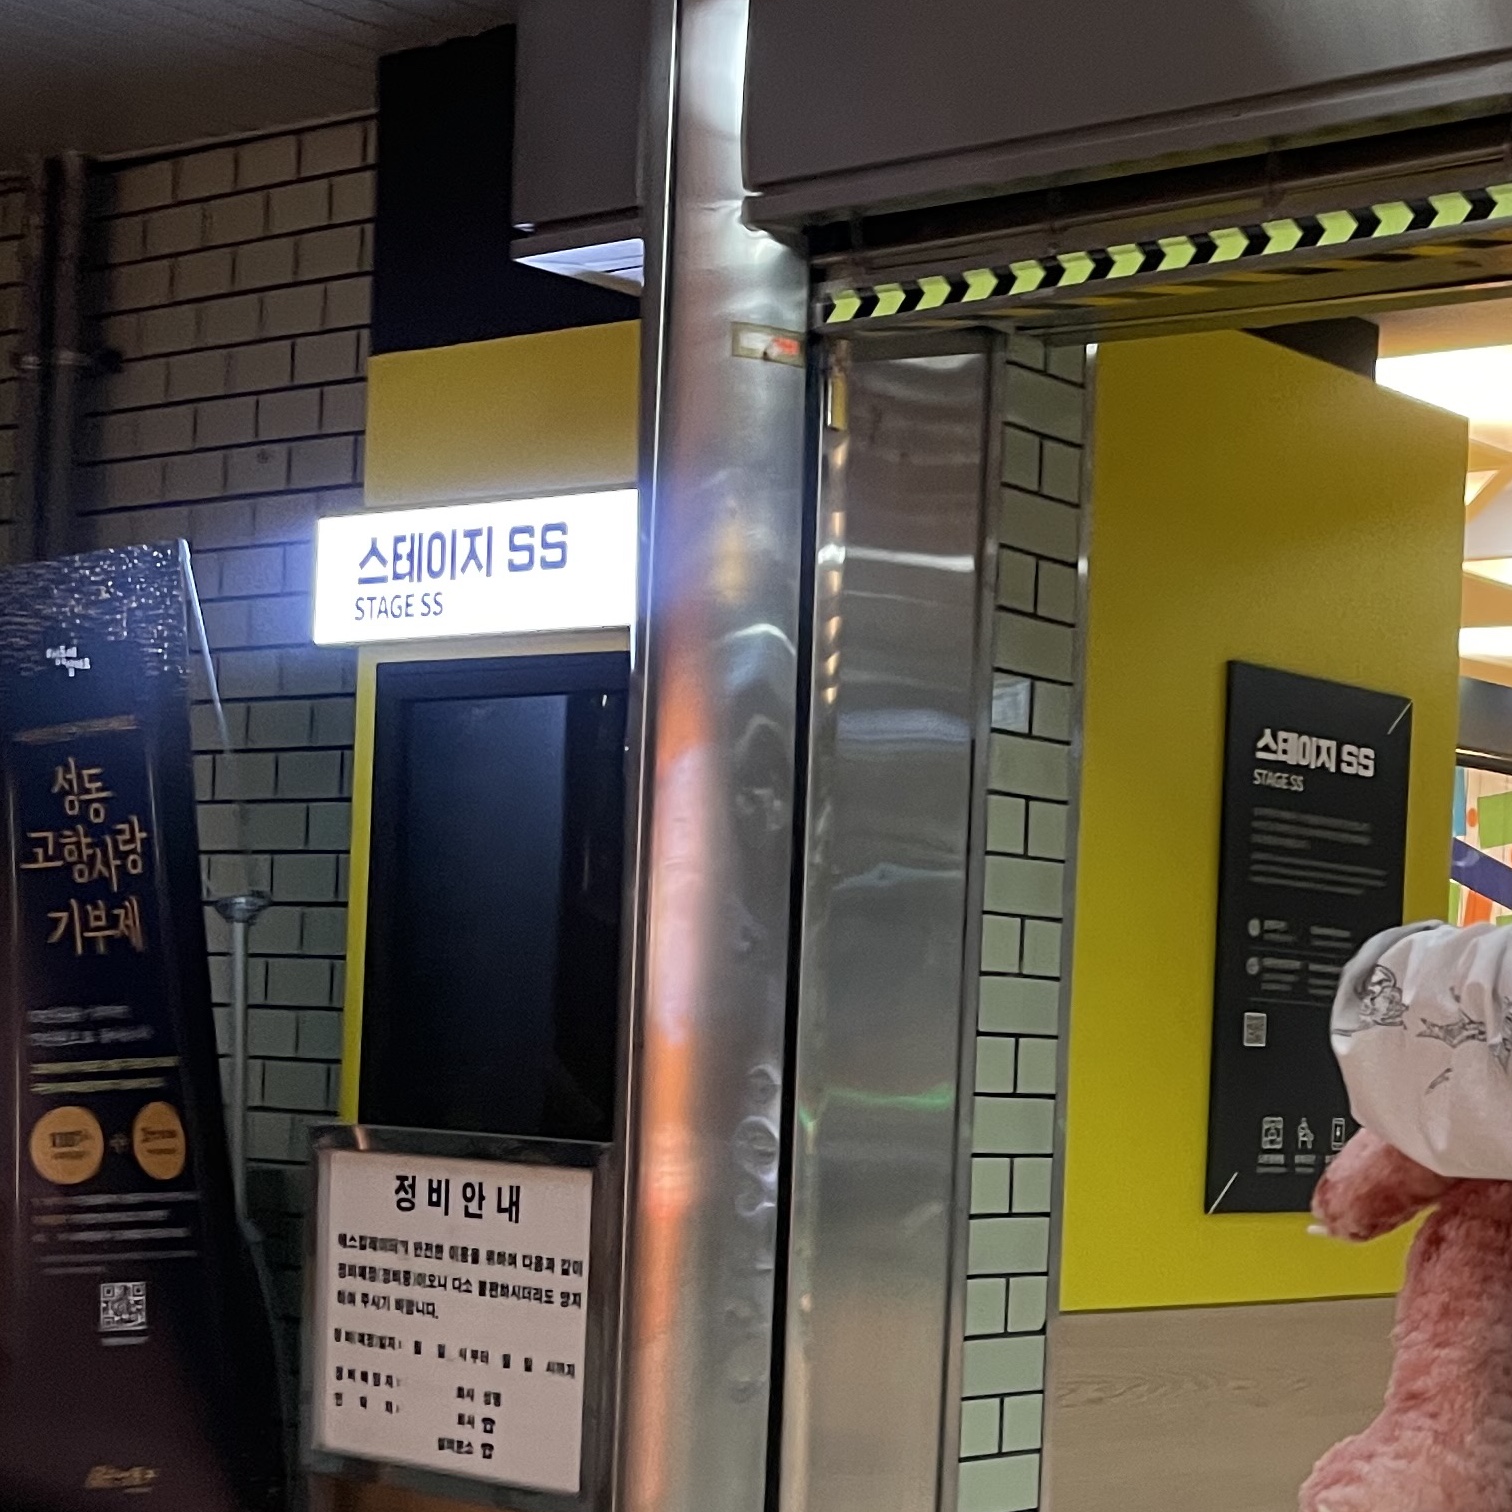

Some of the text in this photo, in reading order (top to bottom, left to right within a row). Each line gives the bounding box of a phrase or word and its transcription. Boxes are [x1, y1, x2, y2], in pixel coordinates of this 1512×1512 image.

[358, 521, 568, 585] 스테이지 SS
[355, 592, 443, 621] STAGE SS
[1253, 769, 1289, 790] STAGE
[1255, 728, 1375, 777] 스테이지 SS
[52, 757, 116, 823] 성동
[20, 815, 147, 892] 고향사랑
[47, 896, 144, 955] 기부제
